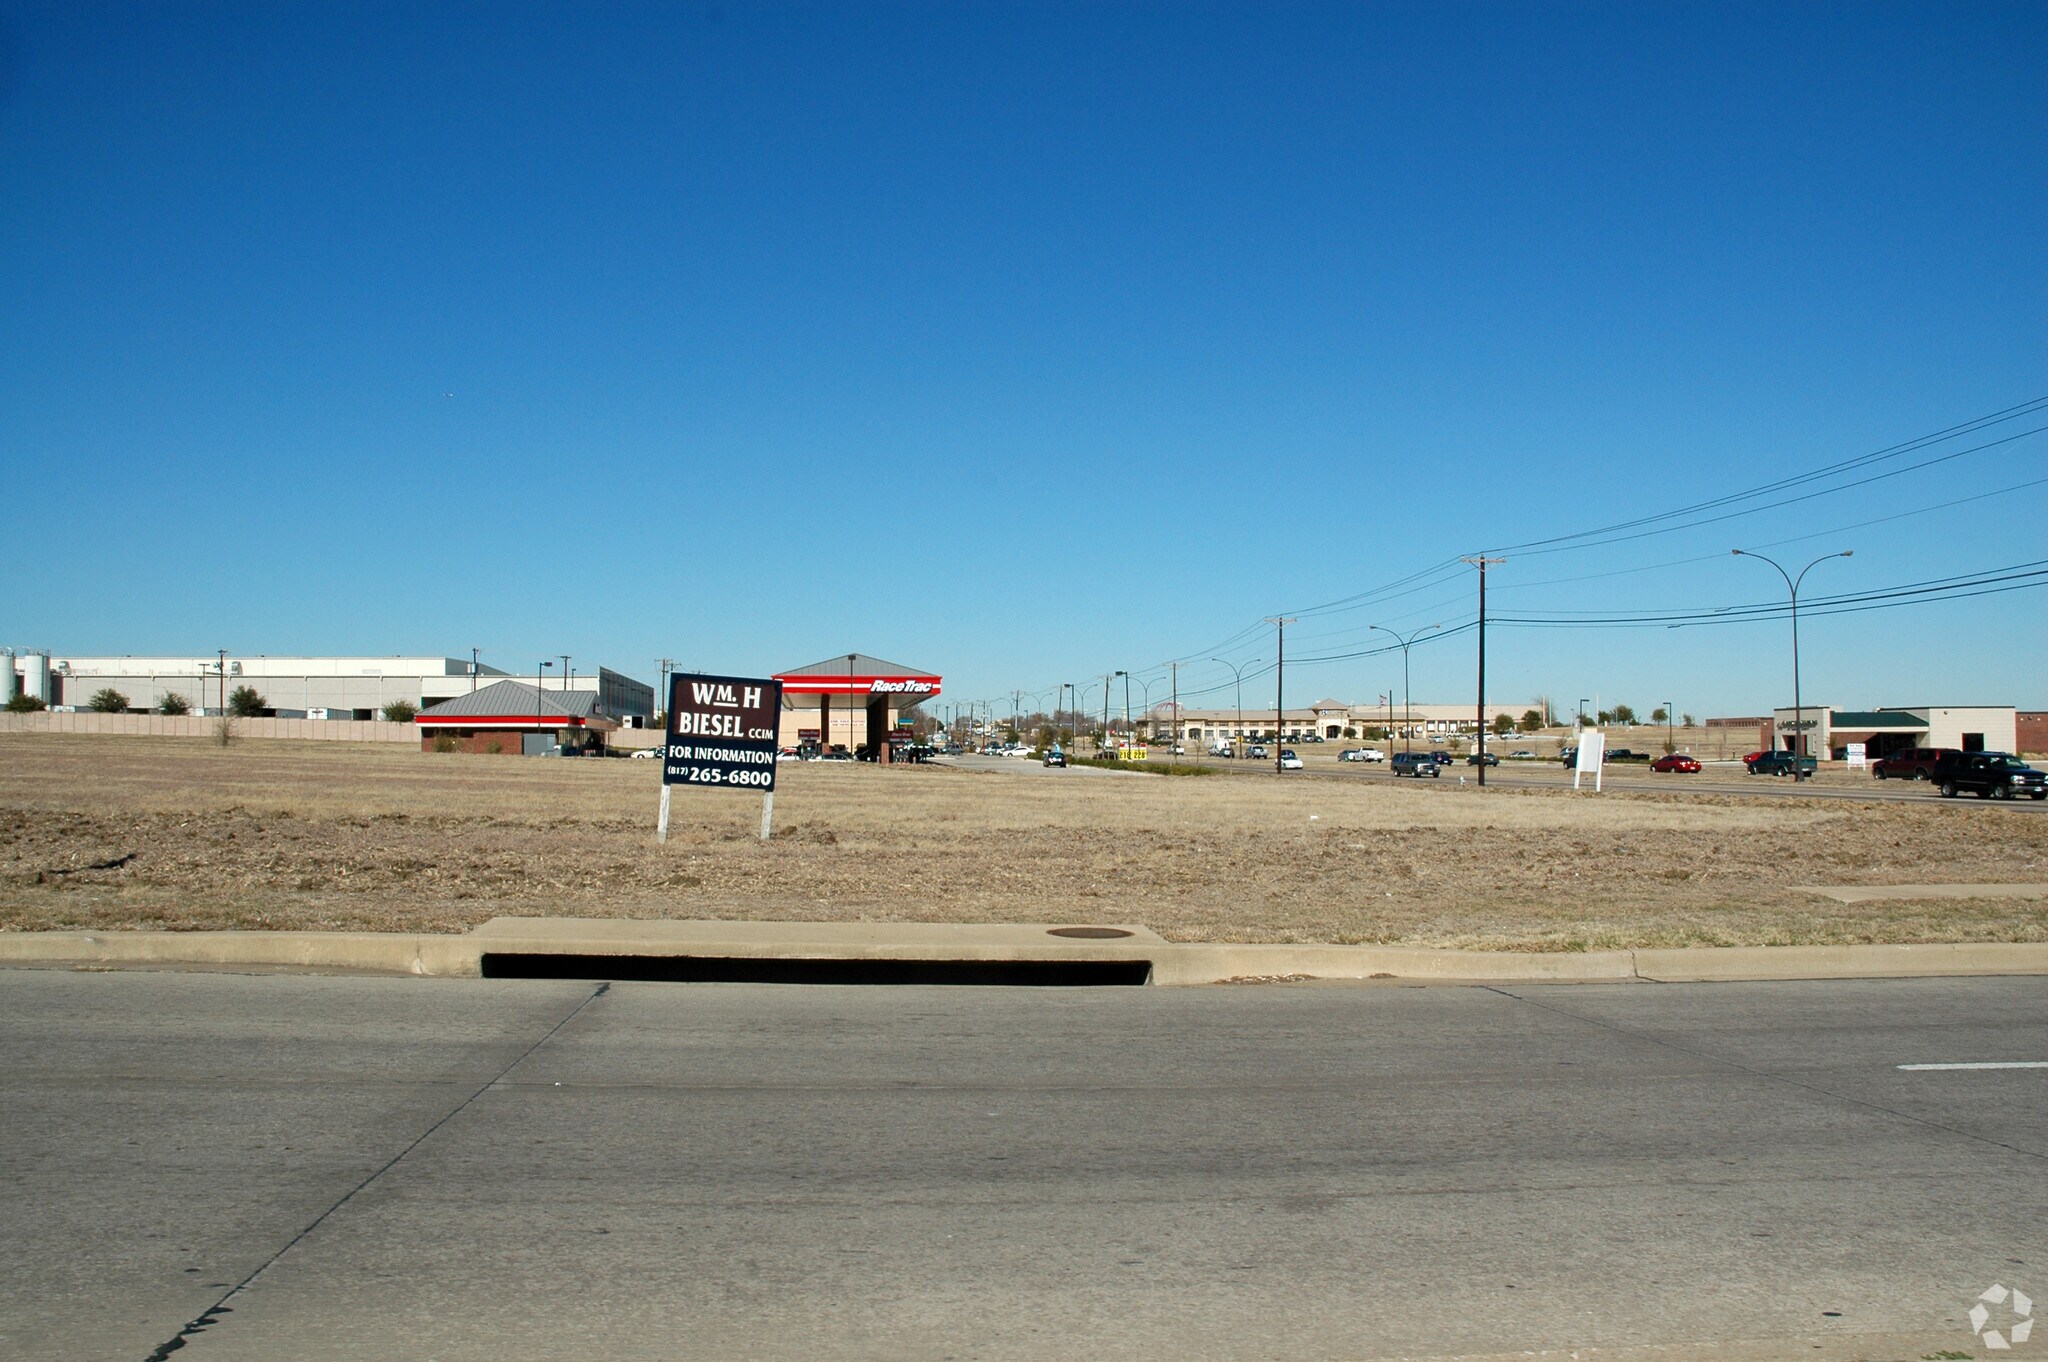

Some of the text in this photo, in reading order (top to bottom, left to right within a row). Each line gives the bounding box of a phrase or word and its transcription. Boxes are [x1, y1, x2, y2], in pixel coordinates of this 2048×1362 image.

[870, 679, 932, 693] RaceTrac
[743, 687, 761, 708] H
[679, 712, 773, 740] BIESEL CCIM
[669, 745, 773, 764] FOR INFORMATION
[667, 766, 772, 786] (817) 265-6800
